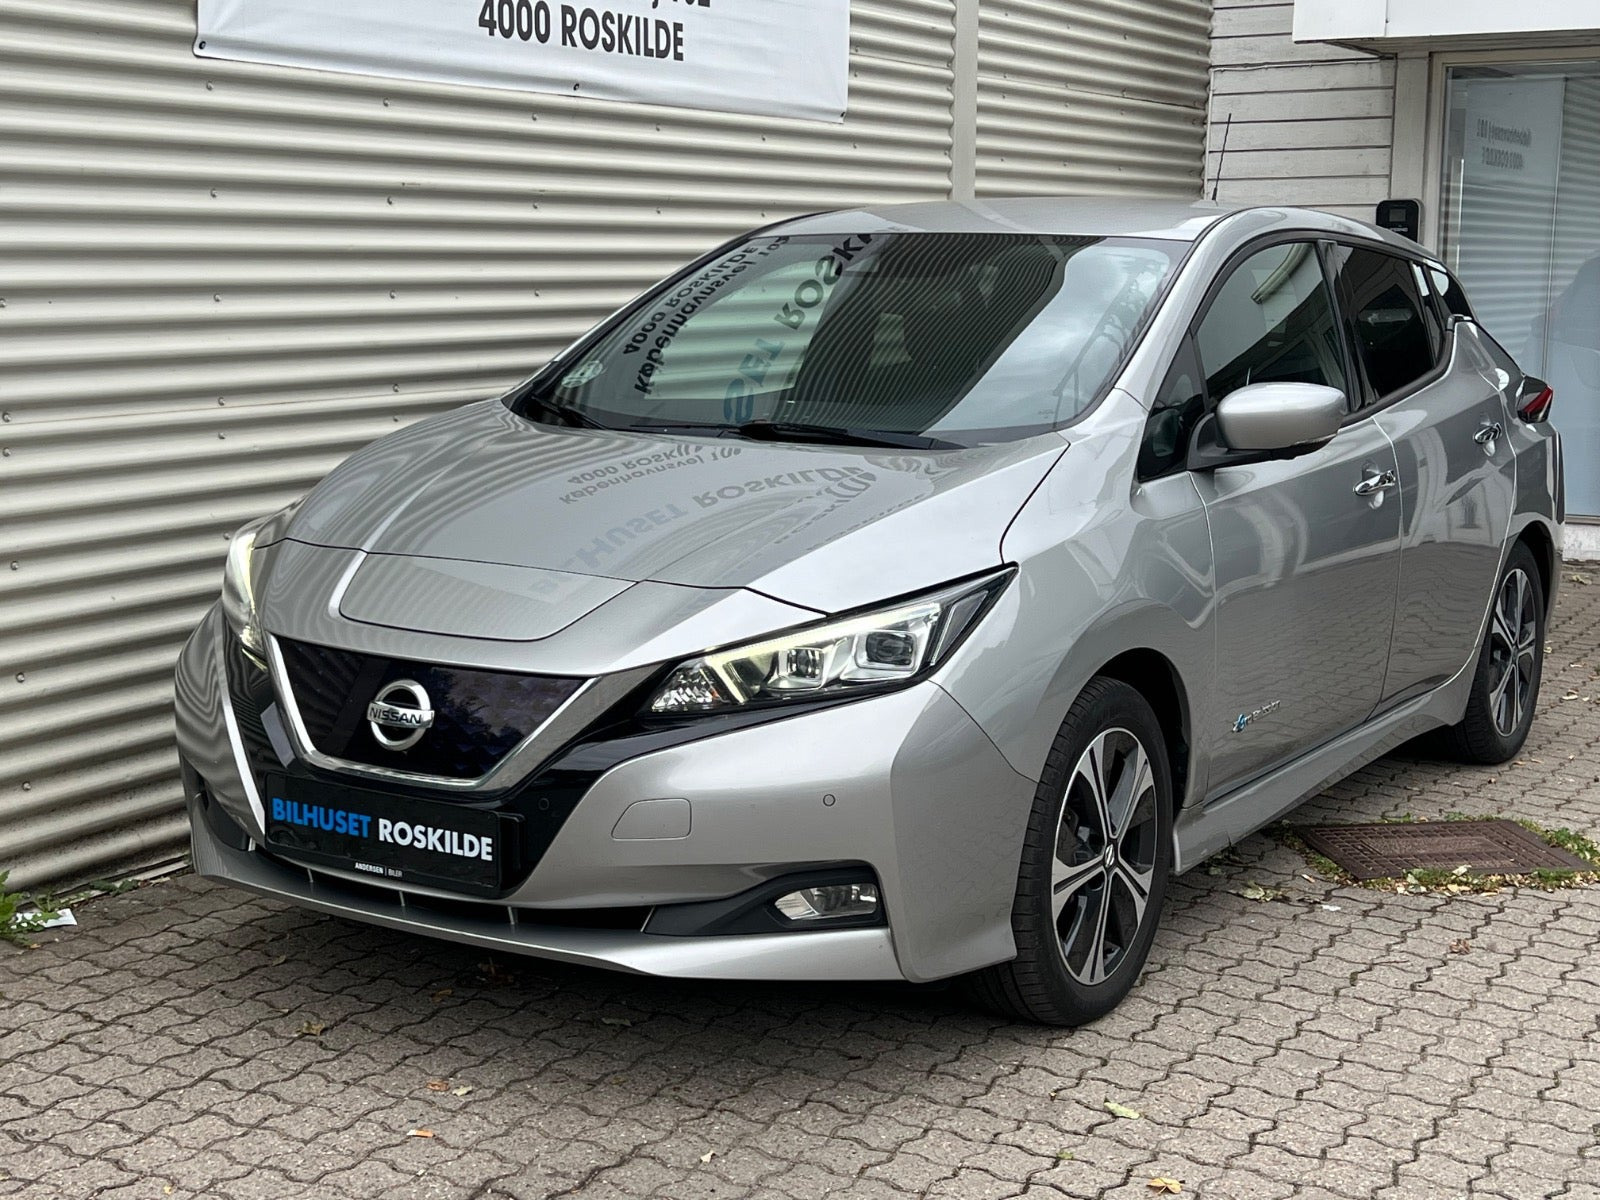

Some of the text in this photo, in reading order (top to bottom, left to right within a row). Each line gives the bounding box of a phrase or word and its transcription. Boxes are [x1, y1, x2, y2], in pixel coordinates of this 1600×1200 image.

[478, 0, 684, 61] 4000 ROSKILDE
[370, 707, 421, 724] NISSAN
[272, 798, 493, 861] BILHUSET ROSKILDE
[355, 862, 384, 874] ANDERSEN
